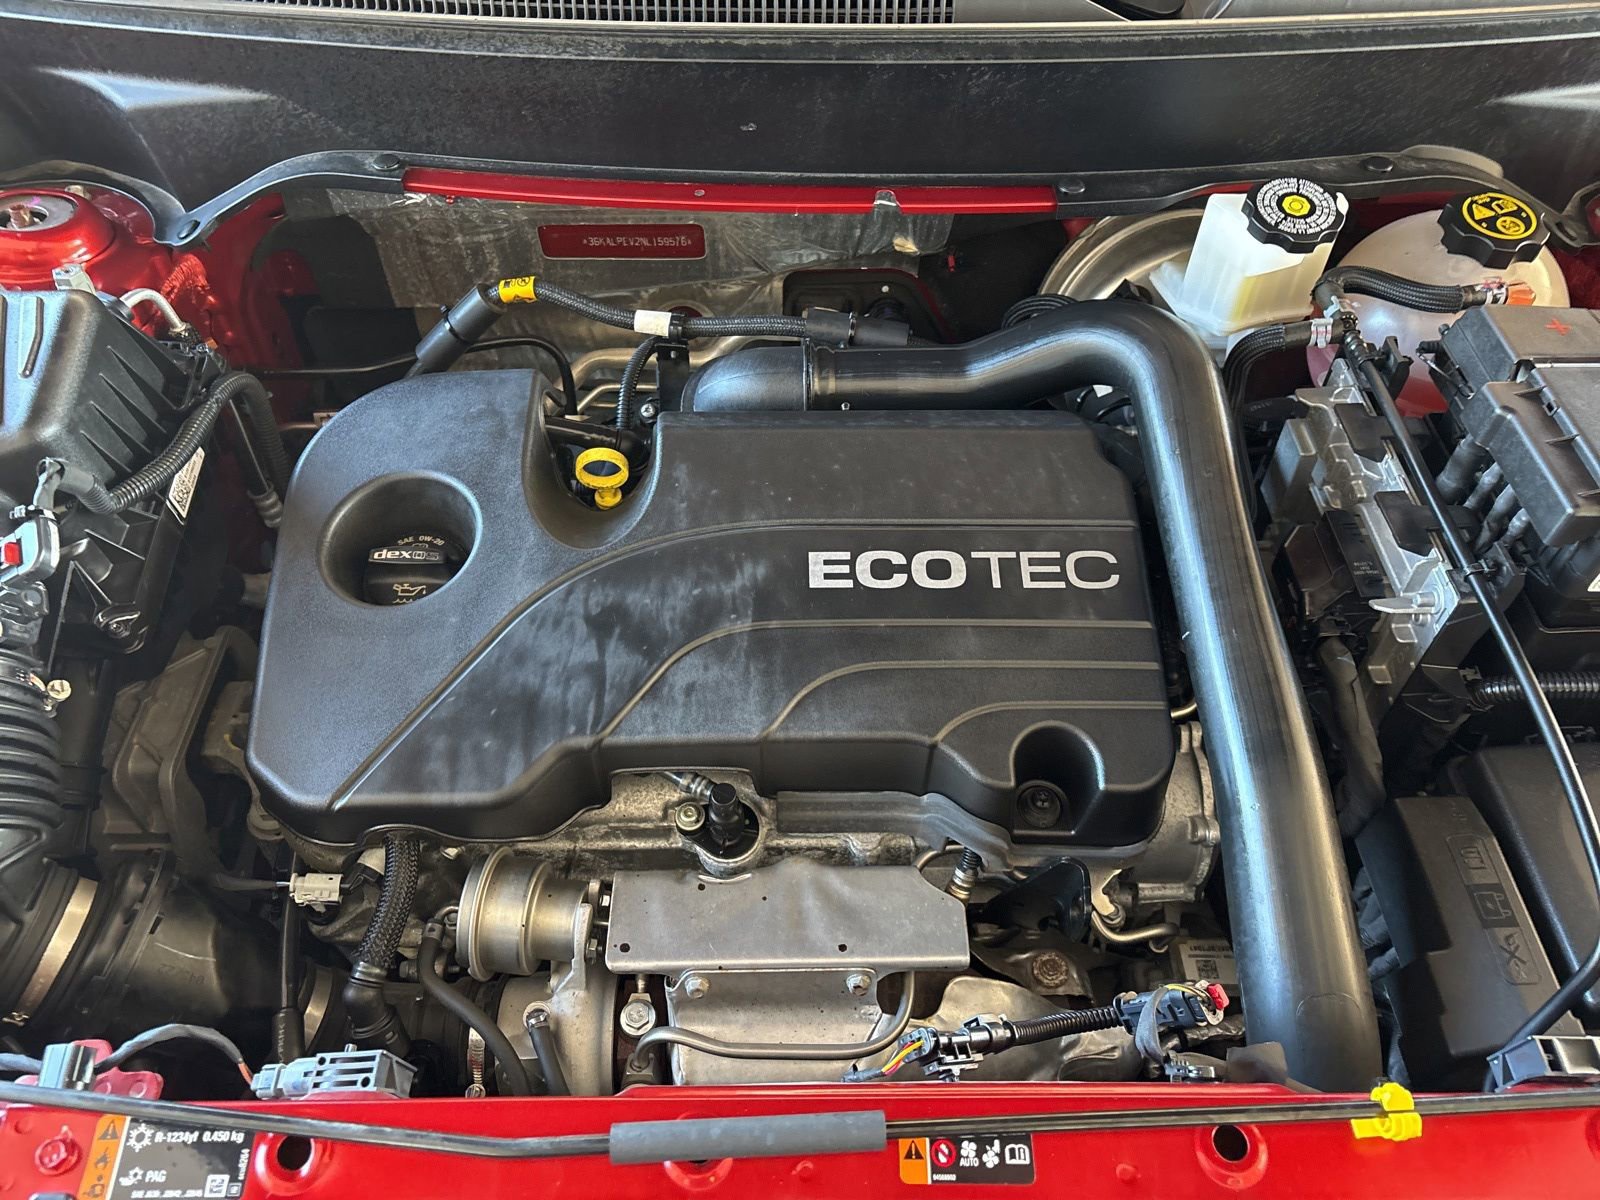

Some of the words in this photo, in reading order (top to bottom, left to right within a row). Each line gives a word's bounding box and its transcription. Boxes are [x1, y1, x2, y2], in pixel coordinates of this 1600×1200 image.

[397, 536, 415, 545] SAE
[419, 535, 445, 545] 0W-20
[373, 548, 441, 561] dexos
[807, 549, 1121, 590] ECOTEC
[154, 1131, 198, 1143] R-1234yf
[202, 1131, 229, 1142] 0.450
[231, 1131, 245, 1144] kg
[960, 1157, 979, 1167] AUTO
[145, 1170, 167, 1182] PAG
